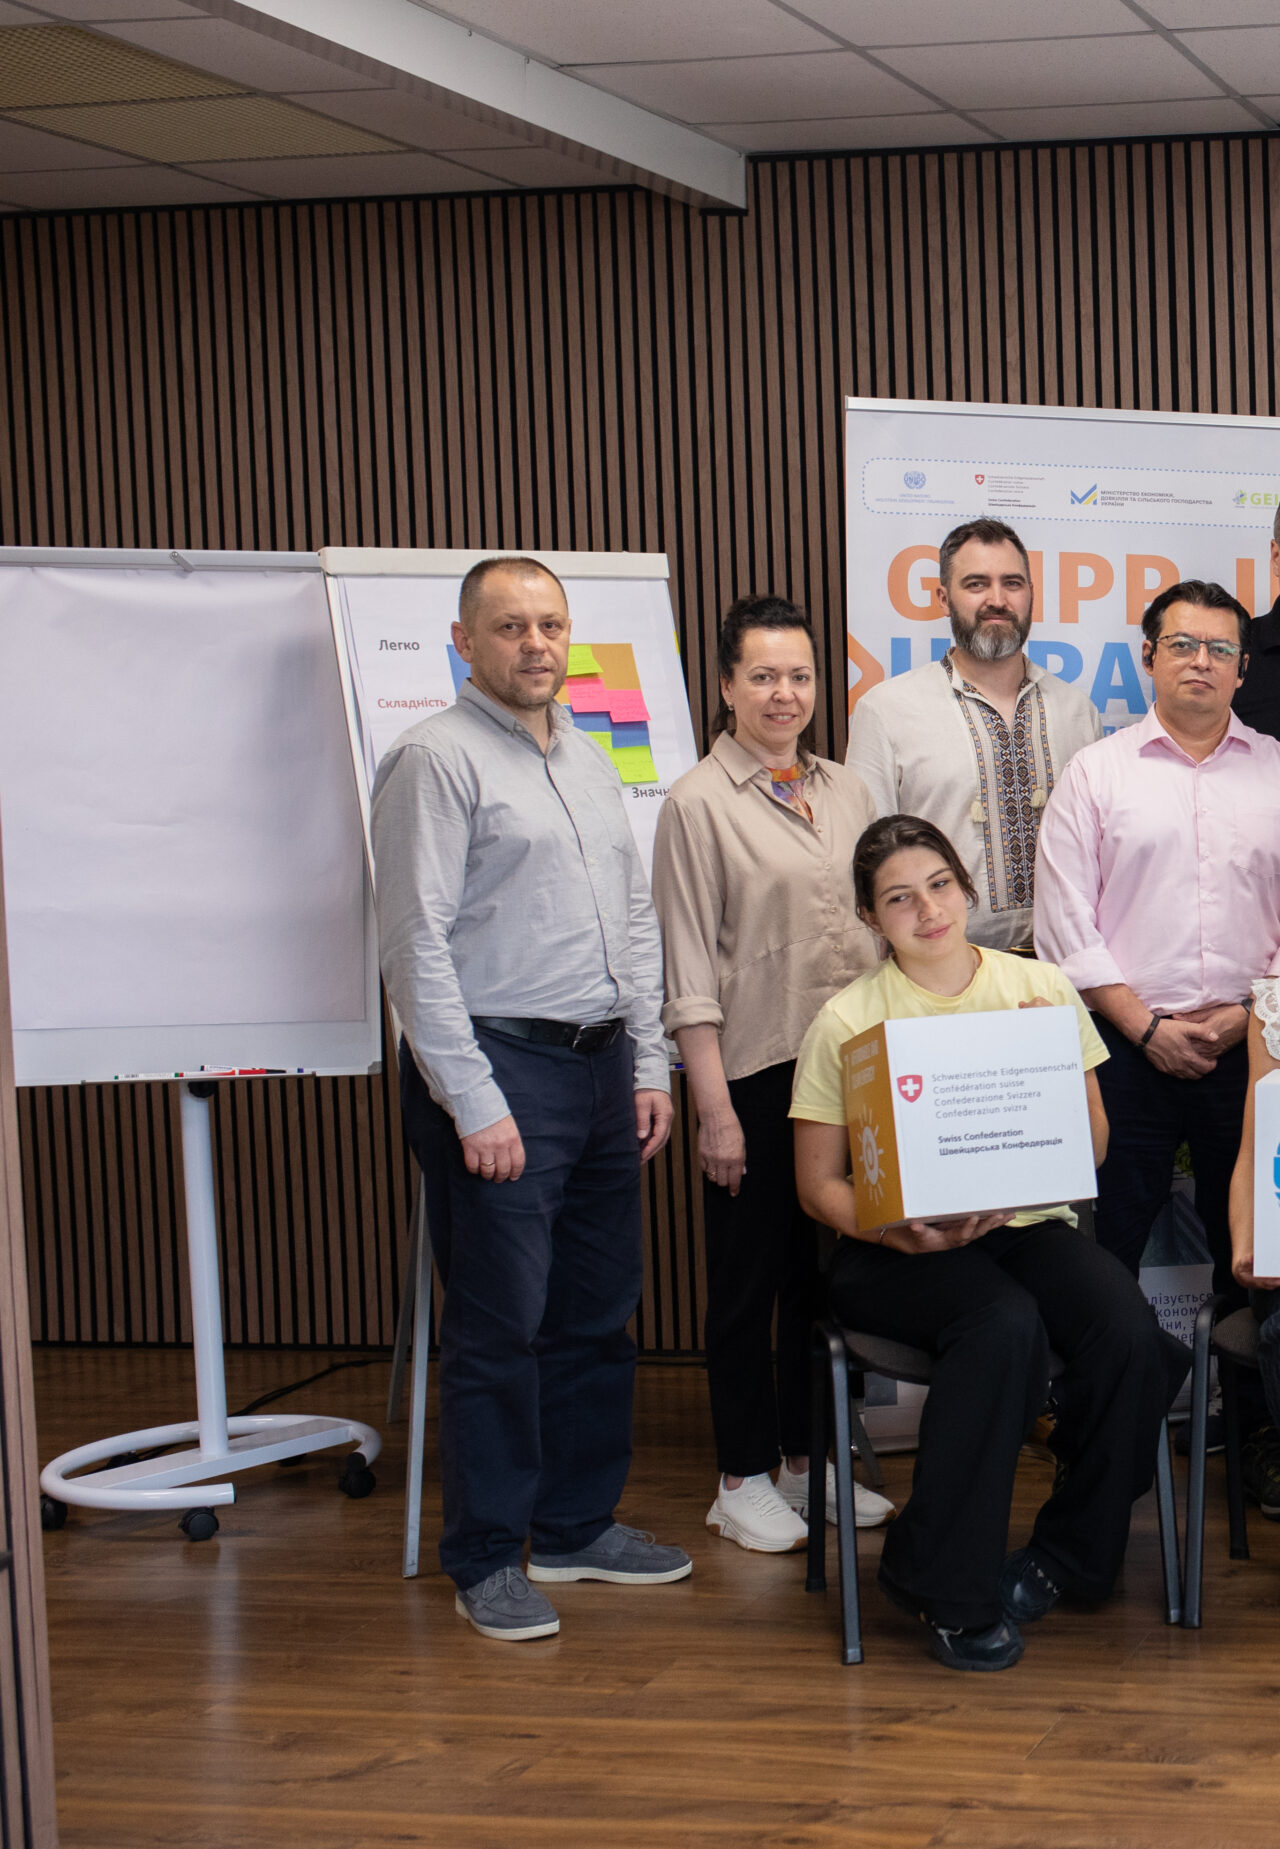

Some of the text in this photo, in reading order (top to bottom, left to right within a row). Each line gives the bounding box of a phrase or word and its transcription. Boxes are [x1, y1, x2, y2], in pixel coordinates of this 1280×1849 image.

[887, 544, 1181, 626] GIPP
[379, 639, 420, 651] Легко
[377, 697, 448, 710] Складність
[932, 1062, 1078, 1082] Schweizerische Eidgenossenschaft
[999, 1079, 1025, 1089] suisse
[934, 1090, 1042, 1107] Confederazione Svizzera
[935, 1103, 1028, 1119] Confederaziun svizra
[938, 1128, 1025, 1144] Swiss Confederation
[939, 1136, 1063, 1156] Швейцарська Конфедерація
